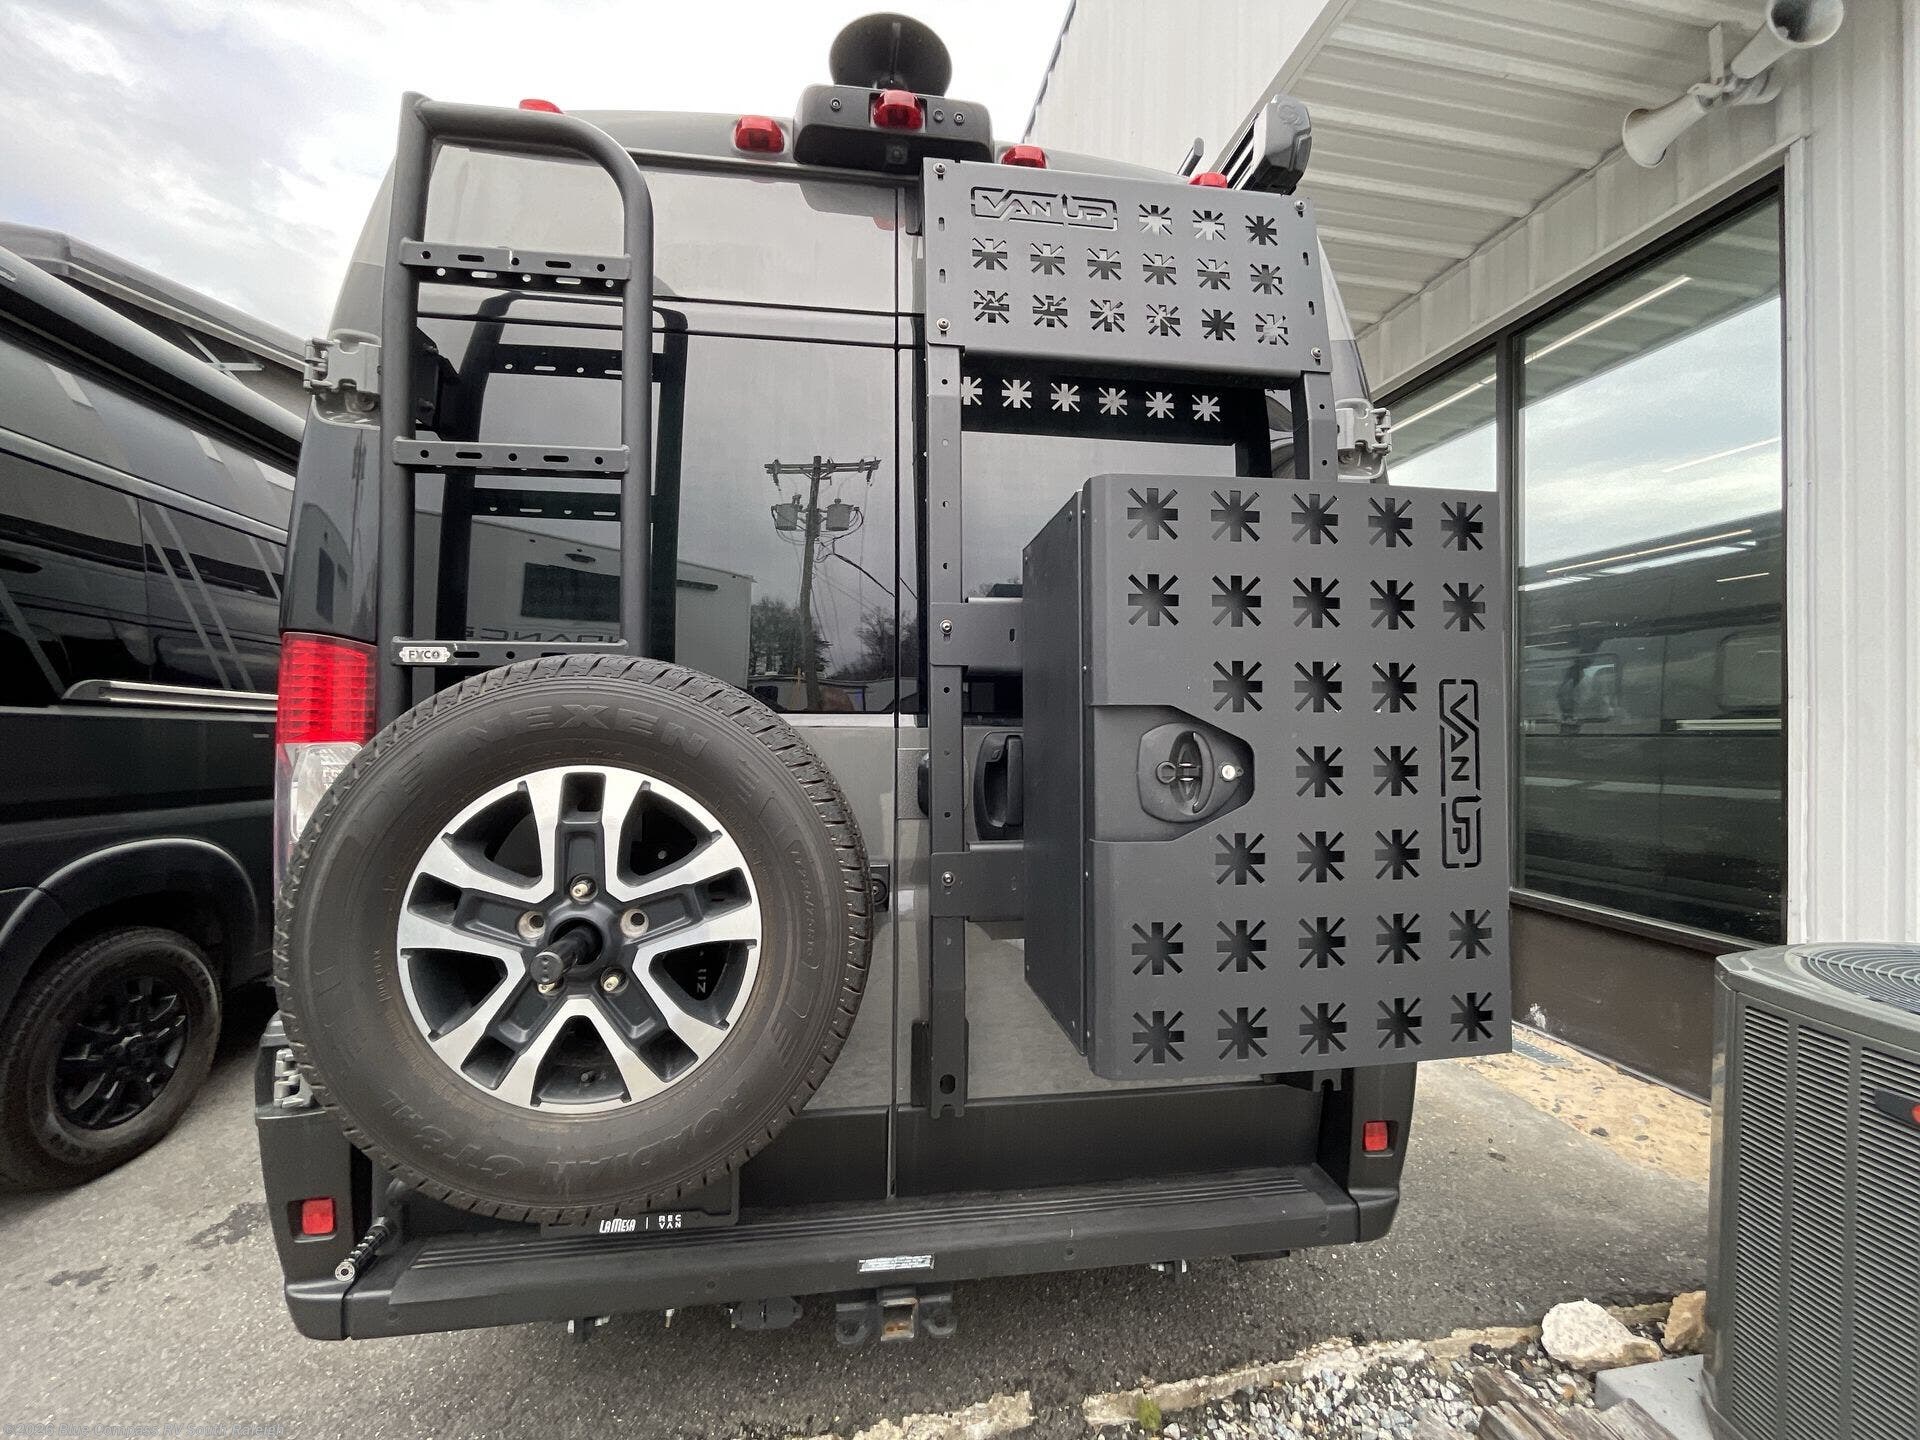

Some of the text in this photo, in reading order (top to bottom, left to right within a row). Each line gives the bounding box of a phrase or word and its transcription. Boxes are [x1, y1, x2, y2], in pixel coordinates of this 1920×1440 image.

[981, 193, 1107, 220] VAN UP
[456, 703, 712, 758] NEXEN
[1449, 692, 1482, 854] VAN UP
[658, 1214, 681, 1222] REC
[658, 1222, 681, 1230] VAN
